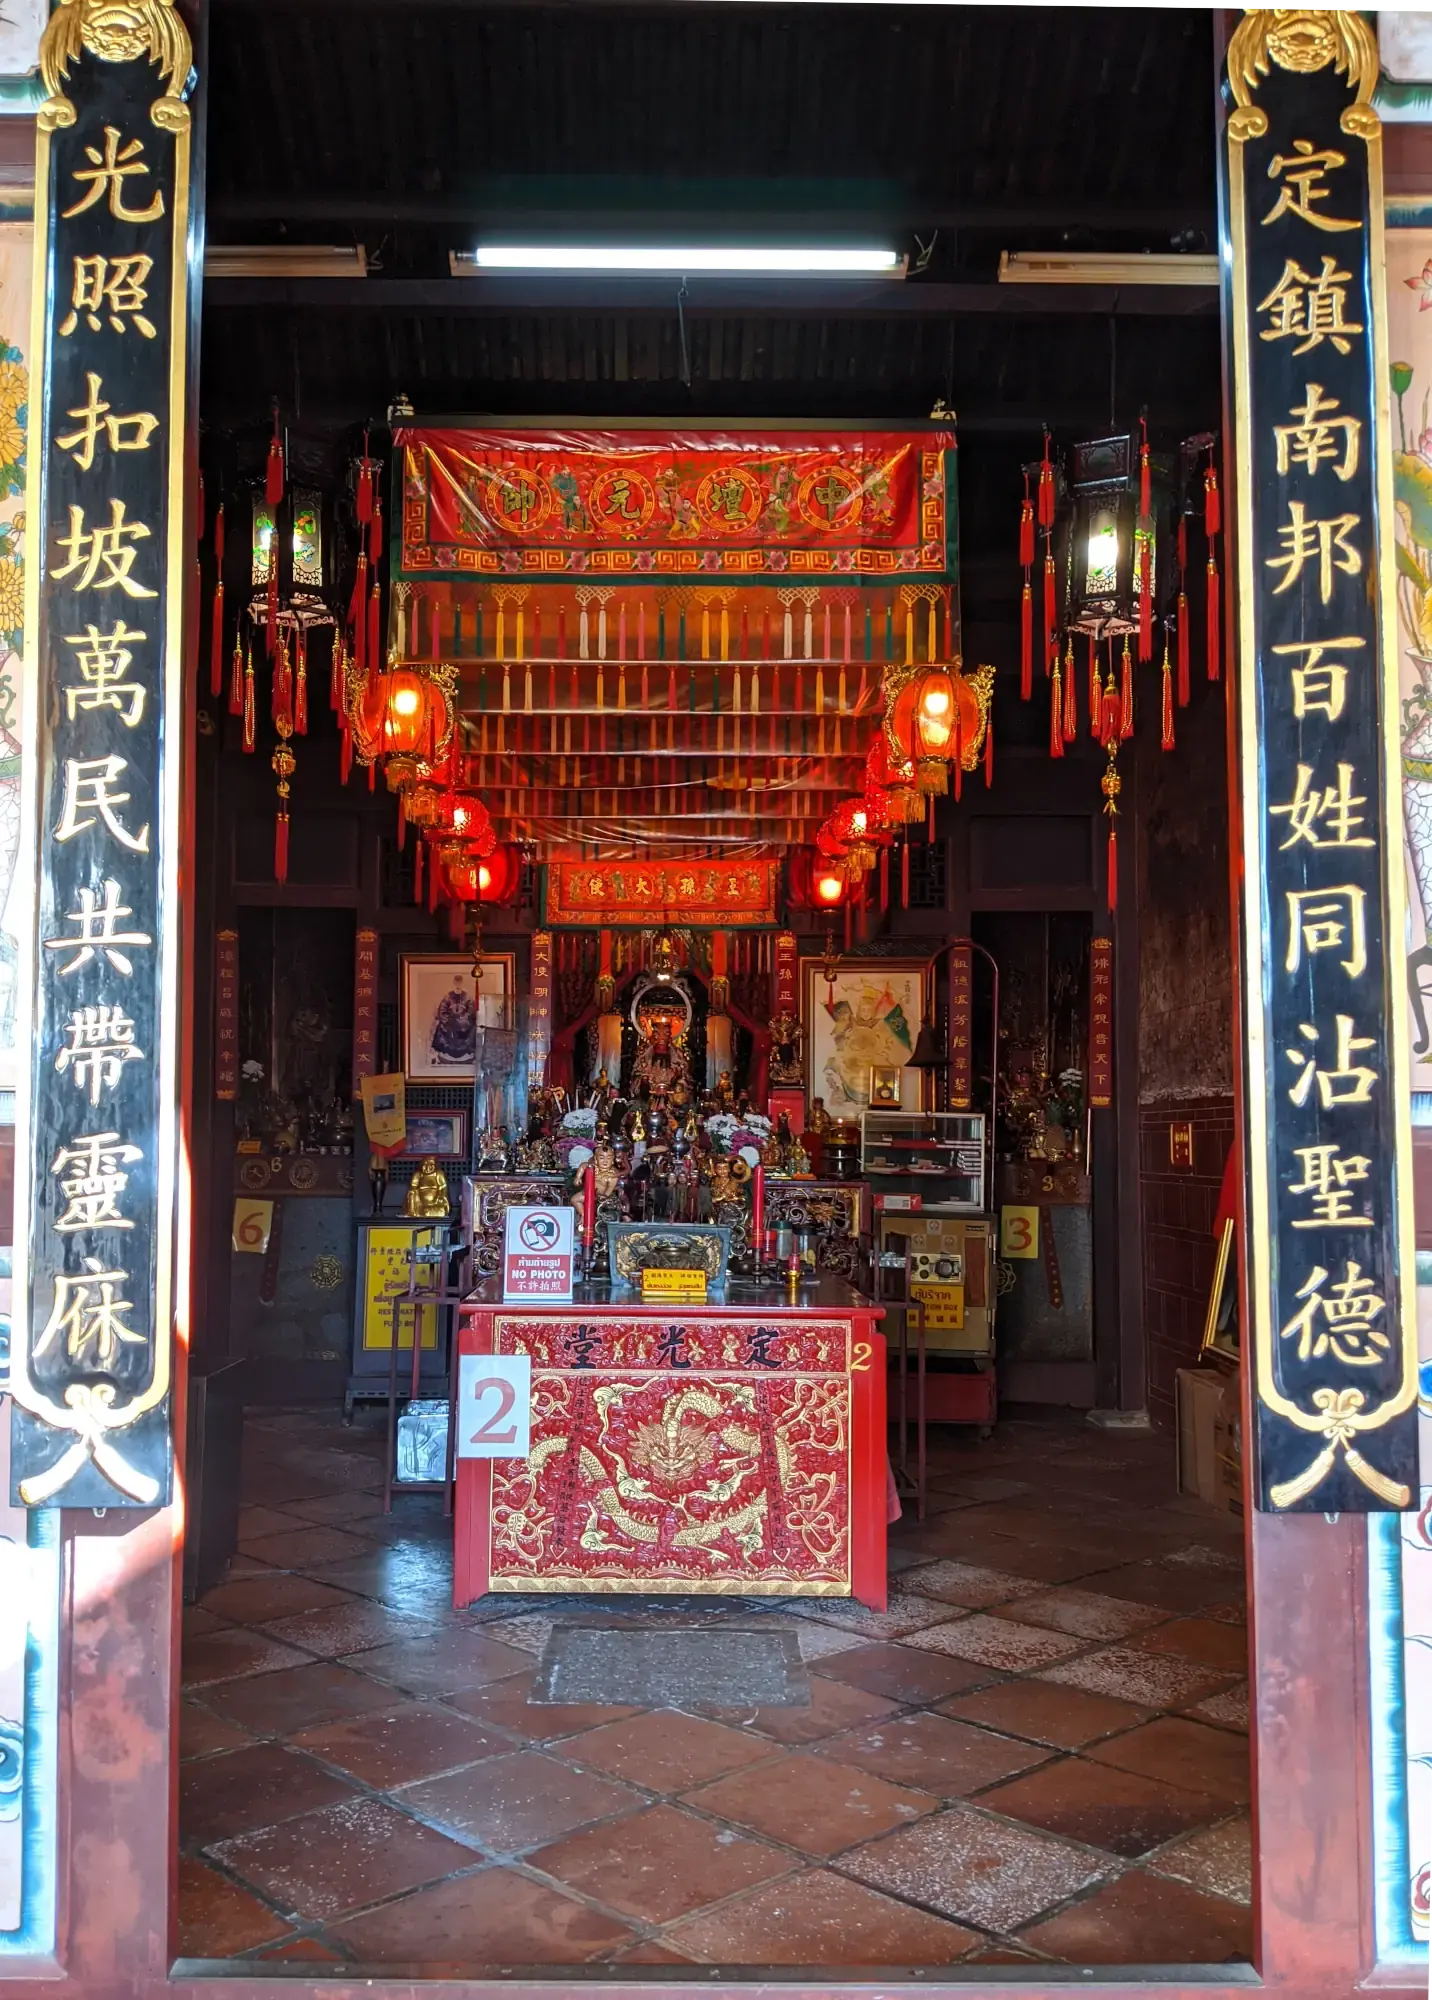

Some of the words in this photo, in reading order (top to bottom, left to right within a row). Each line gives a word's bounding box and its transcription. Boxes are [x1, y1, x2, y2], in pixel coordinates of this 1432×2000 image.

[1257, 139, 1391, 1366] 定鎮南邦百姓同沾聖德
[271, 1157, 282, 1172] 6
[1042, 1175, 1054, 1192] 3
[238, 1211, 263, 1245] 6
[1006, 1217, 1032, 1251] 3
[511, 1270, 527, 1279] NO
[530, 1270, 566, 1279] PHOTO
[518, 1256, 561, 1270] ห้ามถ่ายรูป
[517, 1281, 561, 1292] 不許拍照
[850, 1342, 873, 1372] 2
[470, 1377, 519, 1444] 2
